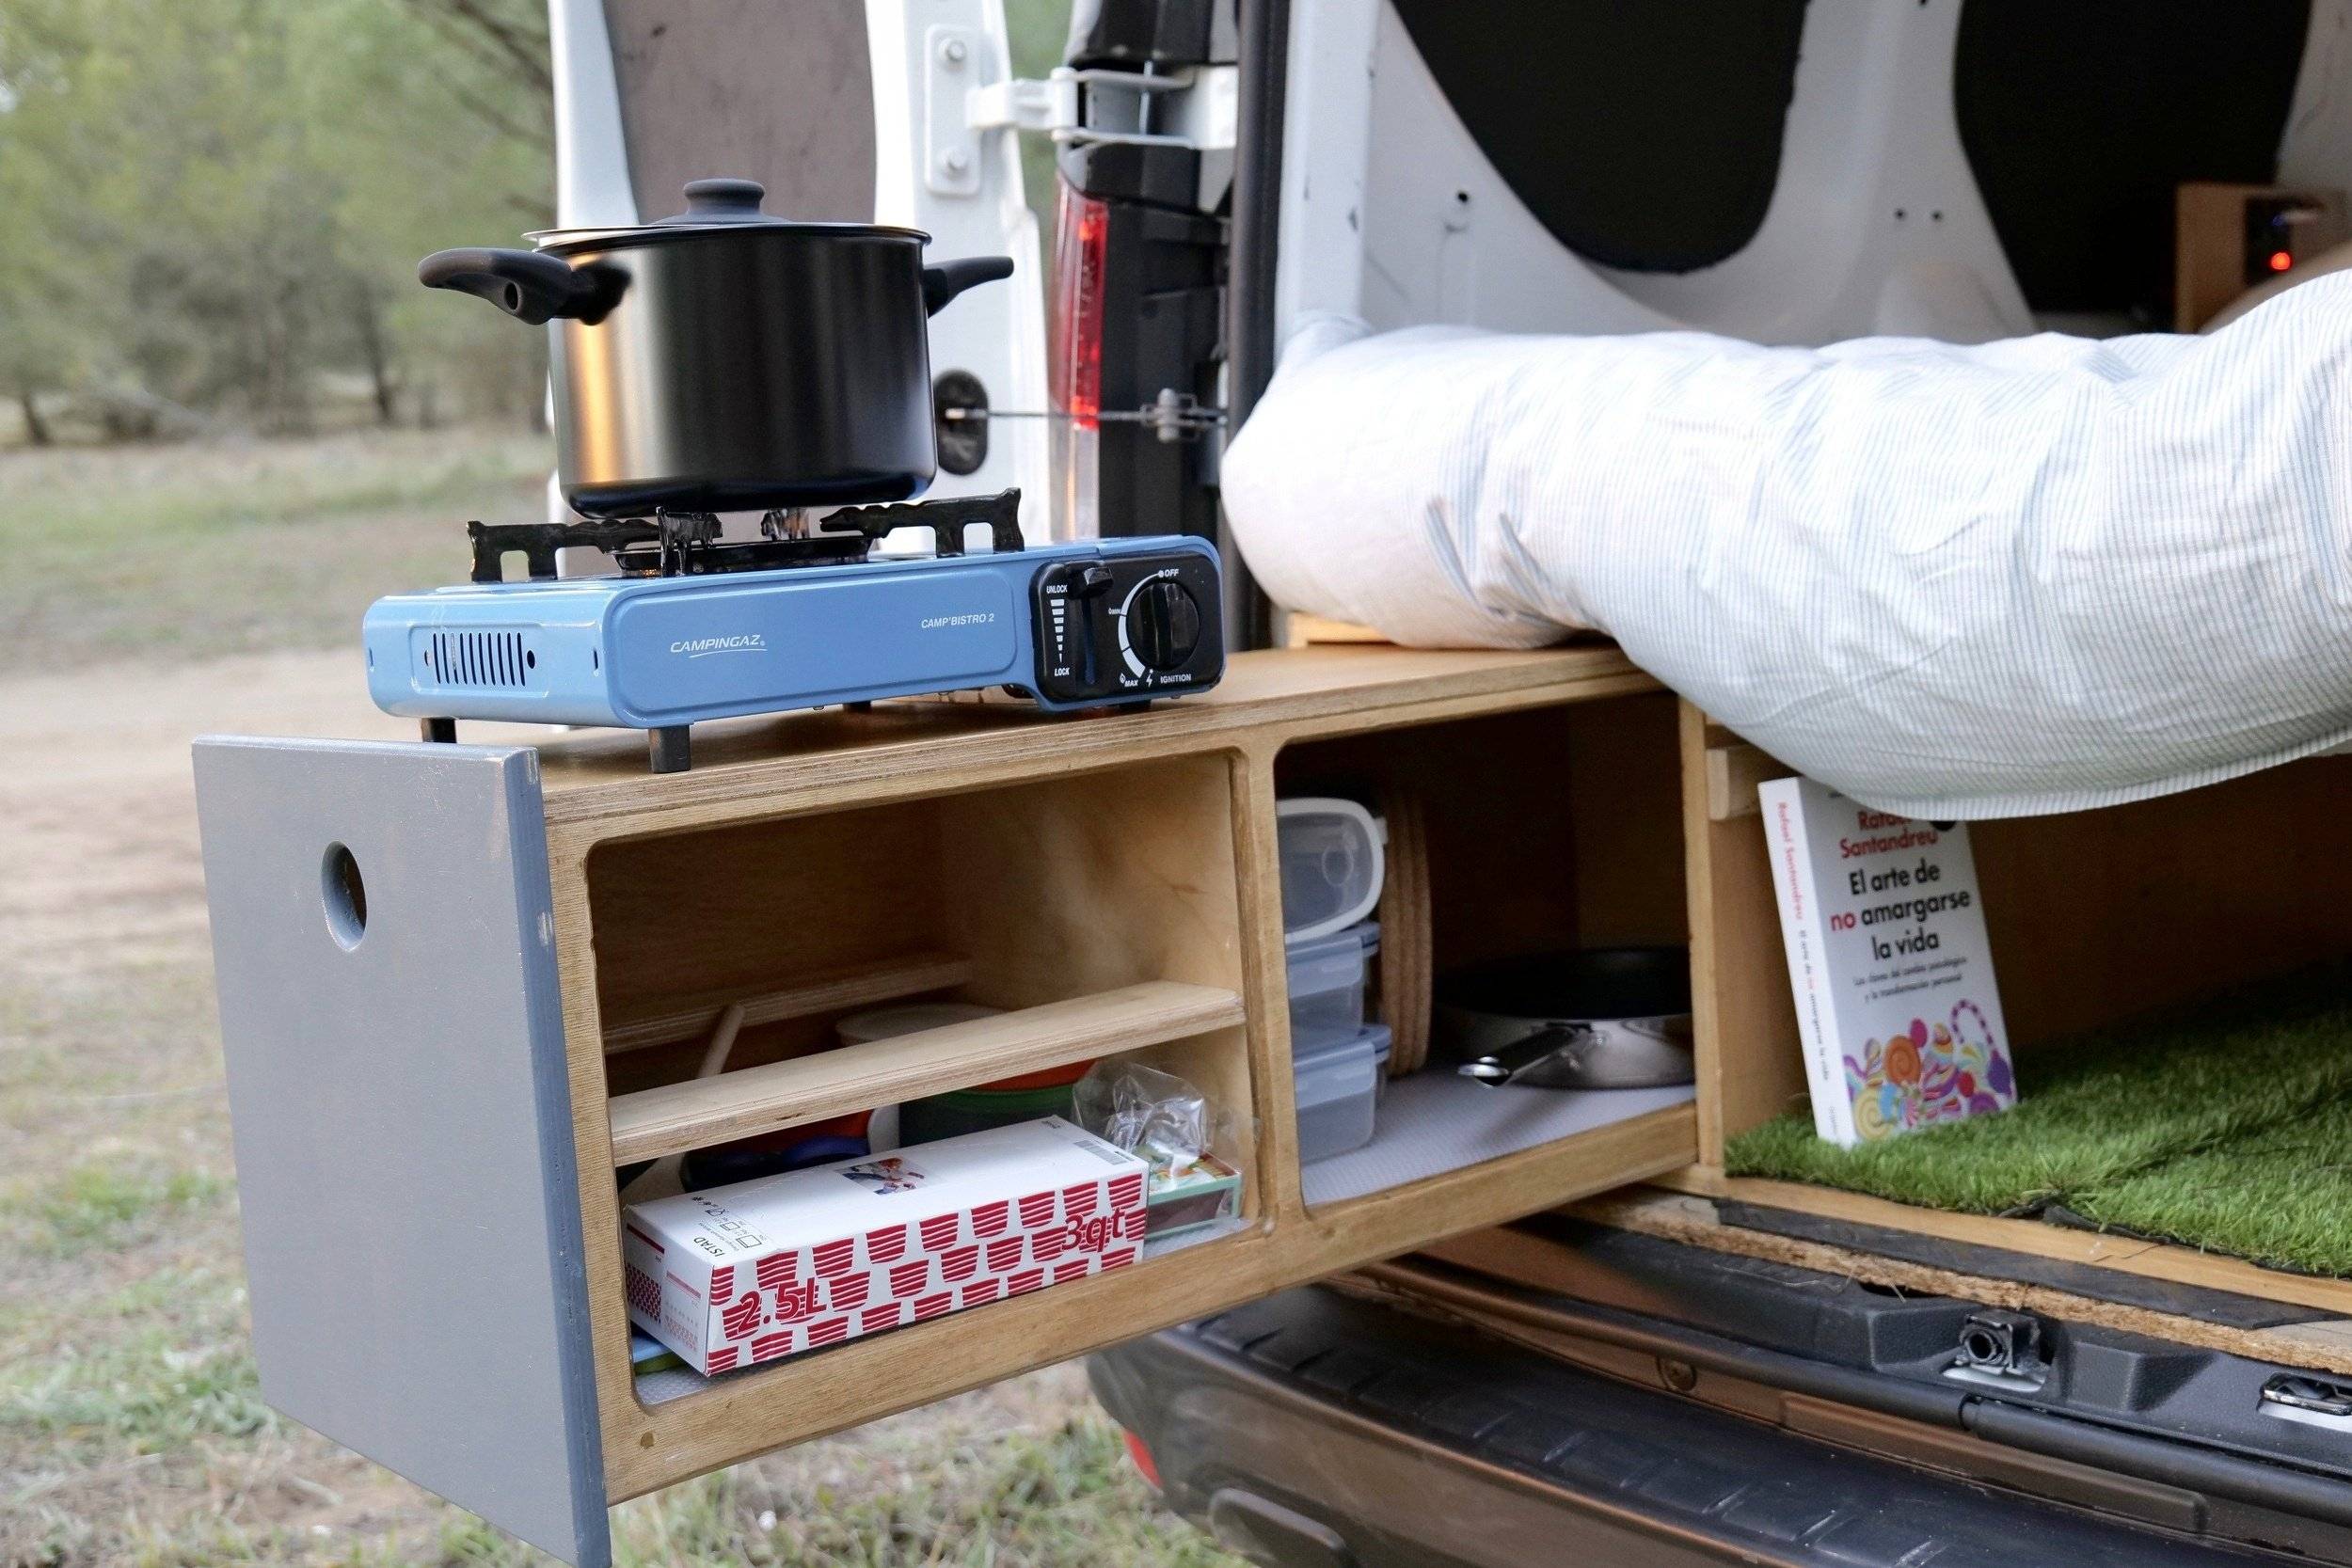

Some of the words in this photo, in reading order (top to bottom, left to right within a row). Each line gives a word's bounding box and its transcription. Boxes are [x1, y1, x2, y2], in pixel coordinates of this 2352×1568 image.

[1164, 568, 1180, 578] OFF
[1046, 584, 1068, 594] UNLOCK
[921, 613, 987, 628] CAMP'BISTRO
[988, 612, 994, 623] 2
[670, 634, 761, 653] CAMPINGAZ
[1054, 667, 1071, 677] LOCK
[1160, 673, 1192, 685] IGNITION
[1839, 826, 1939, 859] Santandreu
[1849, 867, 1867, 895] El
[1870, 866, 1912, 893] arte
[1915, 857, 1941, 885] de
[1830, 911, 1856, 931] no
[1861, 890, 1971, 923] amargarse
[1871, 935, 1892, 961] la
[1896, 926, 1940, 956] vida
[693, 1237, 725, 1258] ISTAD
